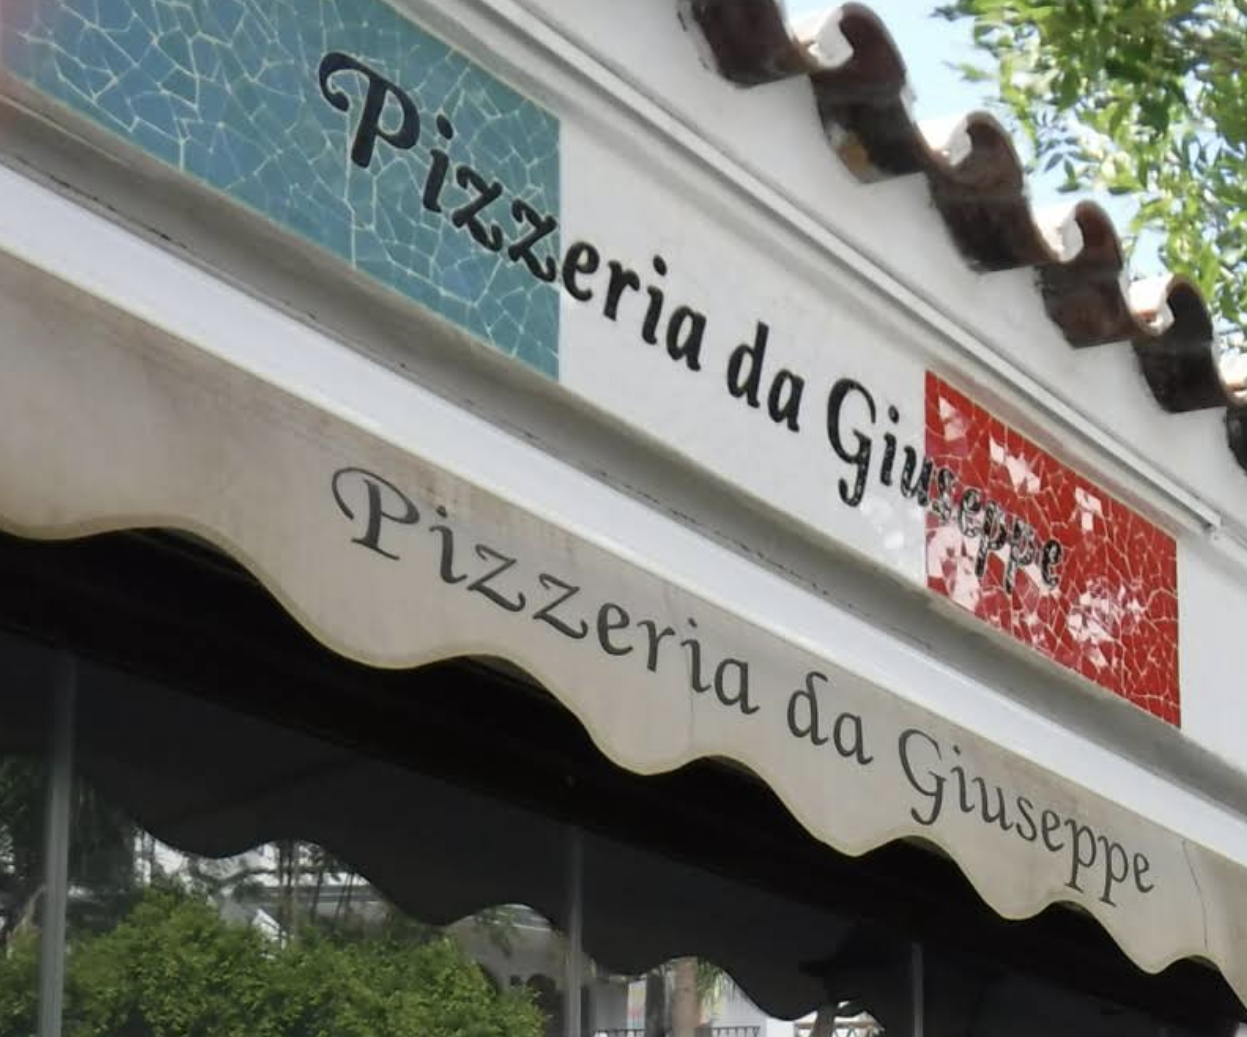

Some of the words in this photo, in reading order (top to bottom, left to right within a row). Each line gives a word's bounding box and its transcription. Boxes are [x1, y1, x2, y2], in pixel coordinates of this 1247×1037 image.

[318, 50, 706, 372] Pizzeria
[728, 322, 805, 432] da
[827, 378, 1063, 595] Giuseppe
[330, 466, 761, 716] Pizzeria
[786, 670, 875, 766] da
[898, 728, 1155, 908] Giuseppe
